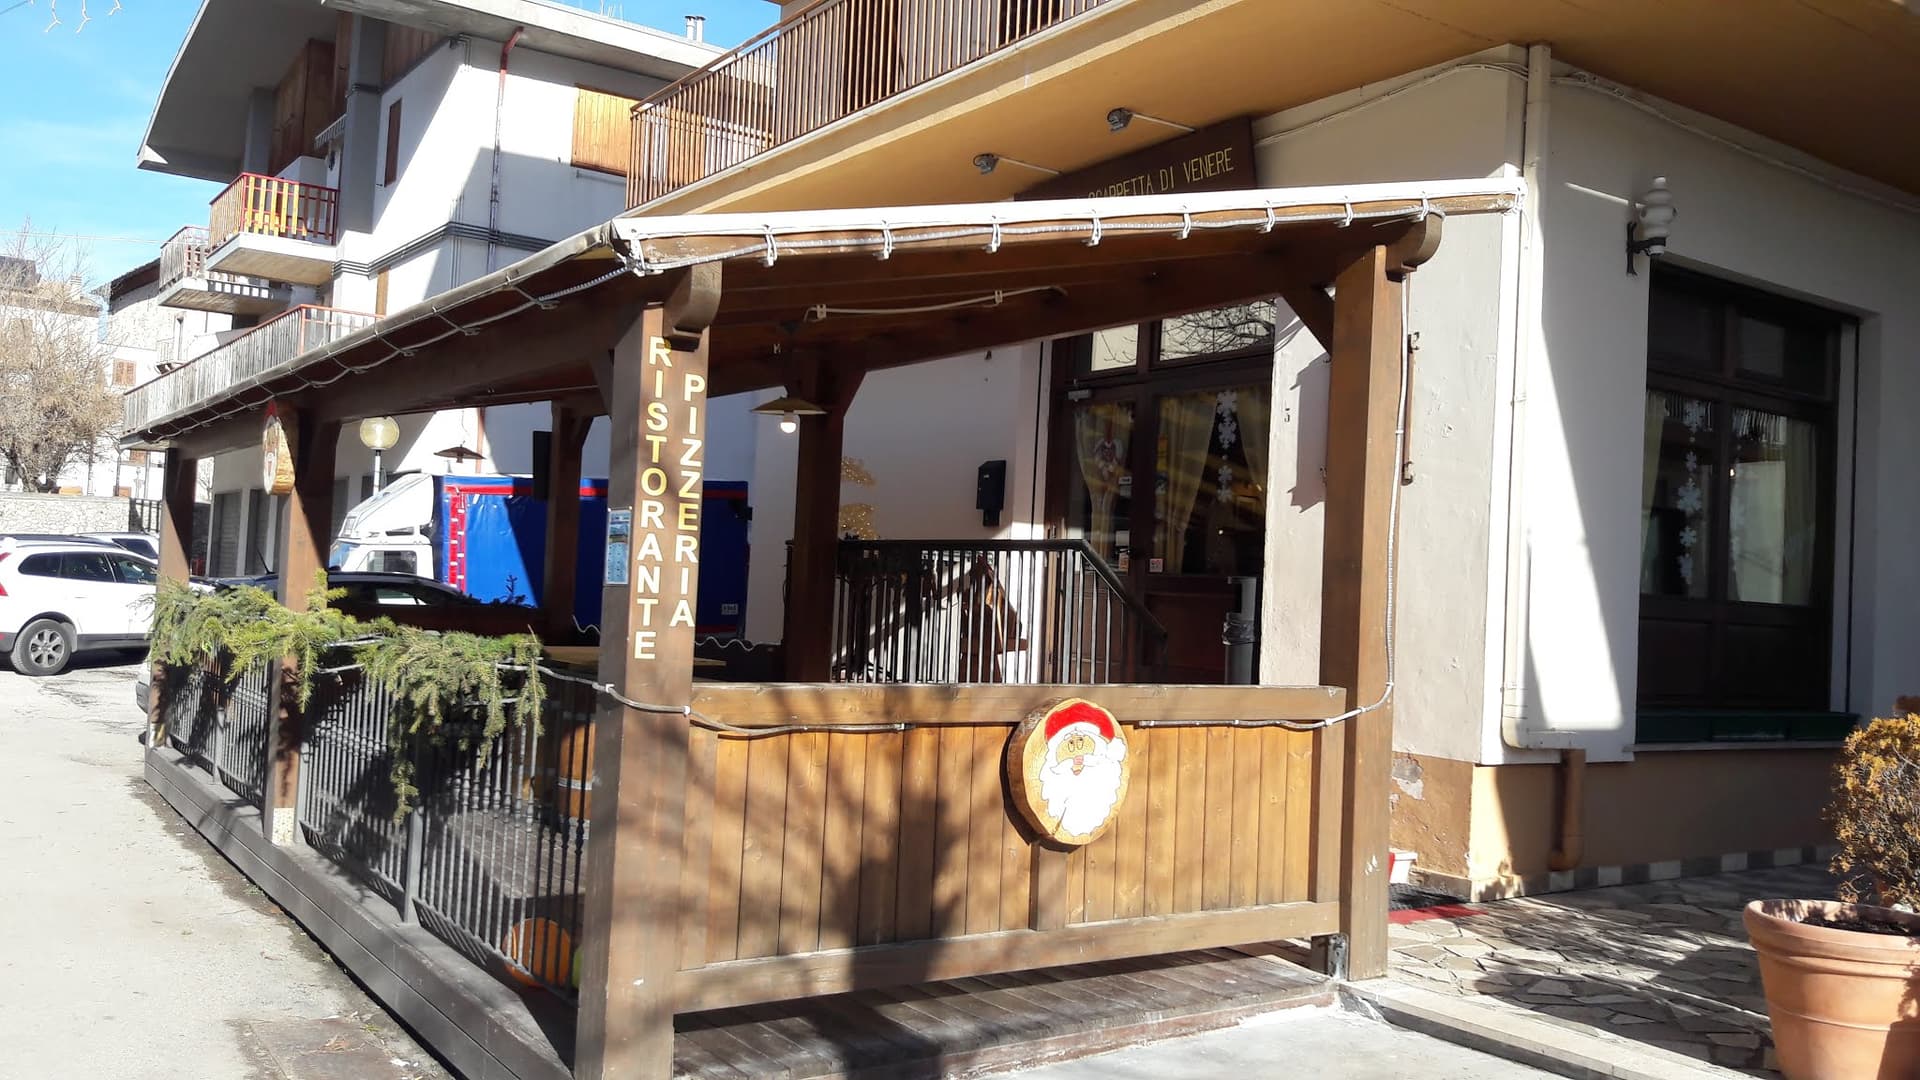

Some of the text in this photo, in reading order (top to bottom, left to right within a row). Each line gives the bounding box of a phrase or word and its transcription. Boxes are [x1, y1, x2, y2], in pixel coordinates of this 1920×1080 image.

[1159, 166, 1175, 191] DI
[1183, 147, 1234, 184] VENERE
[633, 335, 673, 660] RISTORANTE
[669, 373, 706, 628] PIZZERIA
